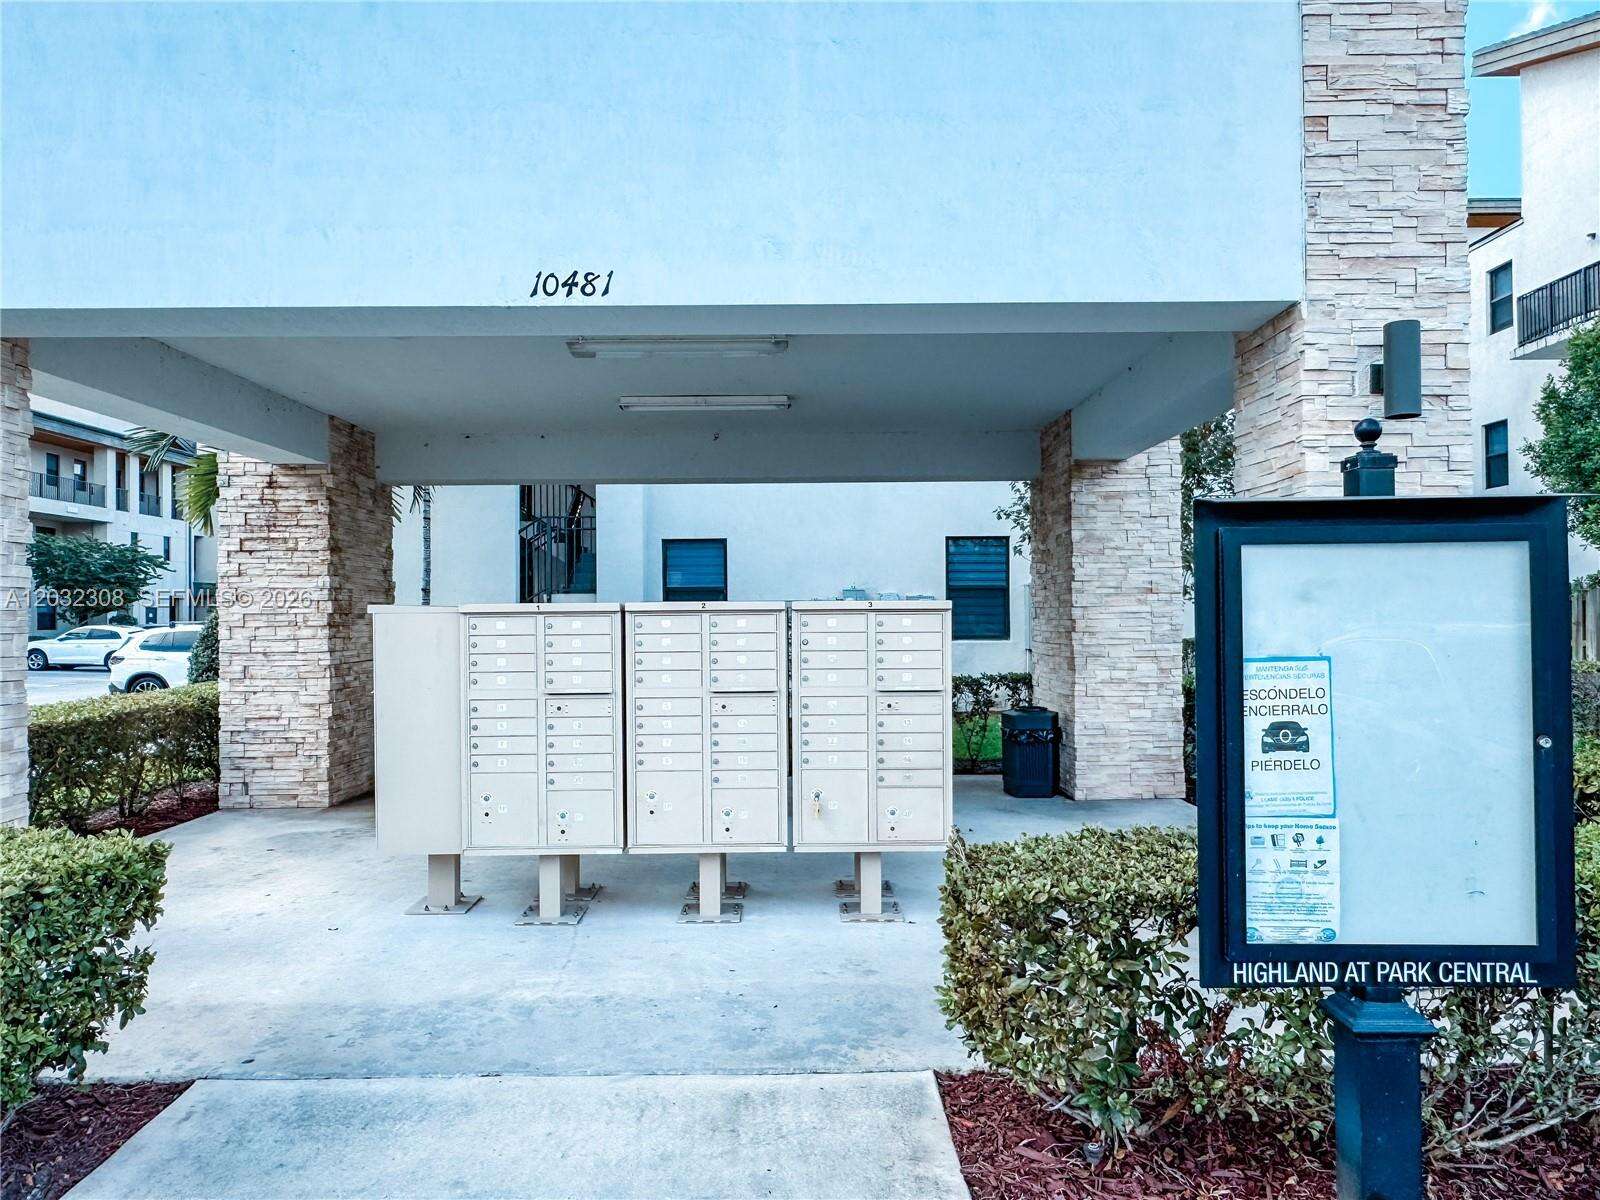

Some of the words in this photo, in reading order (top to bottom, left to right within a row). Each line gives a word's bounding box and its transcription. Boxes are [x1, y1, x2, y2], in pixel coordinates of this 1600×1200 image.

[529, 270, 614, 298] 10481
[1251, 757, 1321, 771] PIÉRDELO
[1233, 962, 1339, 984] HIGHLAND
[1344, 962, 1370, 983] AT
[1377, 962, 1433, 983] PARK
[1438, 962, 1538, 984] CENTRAL
